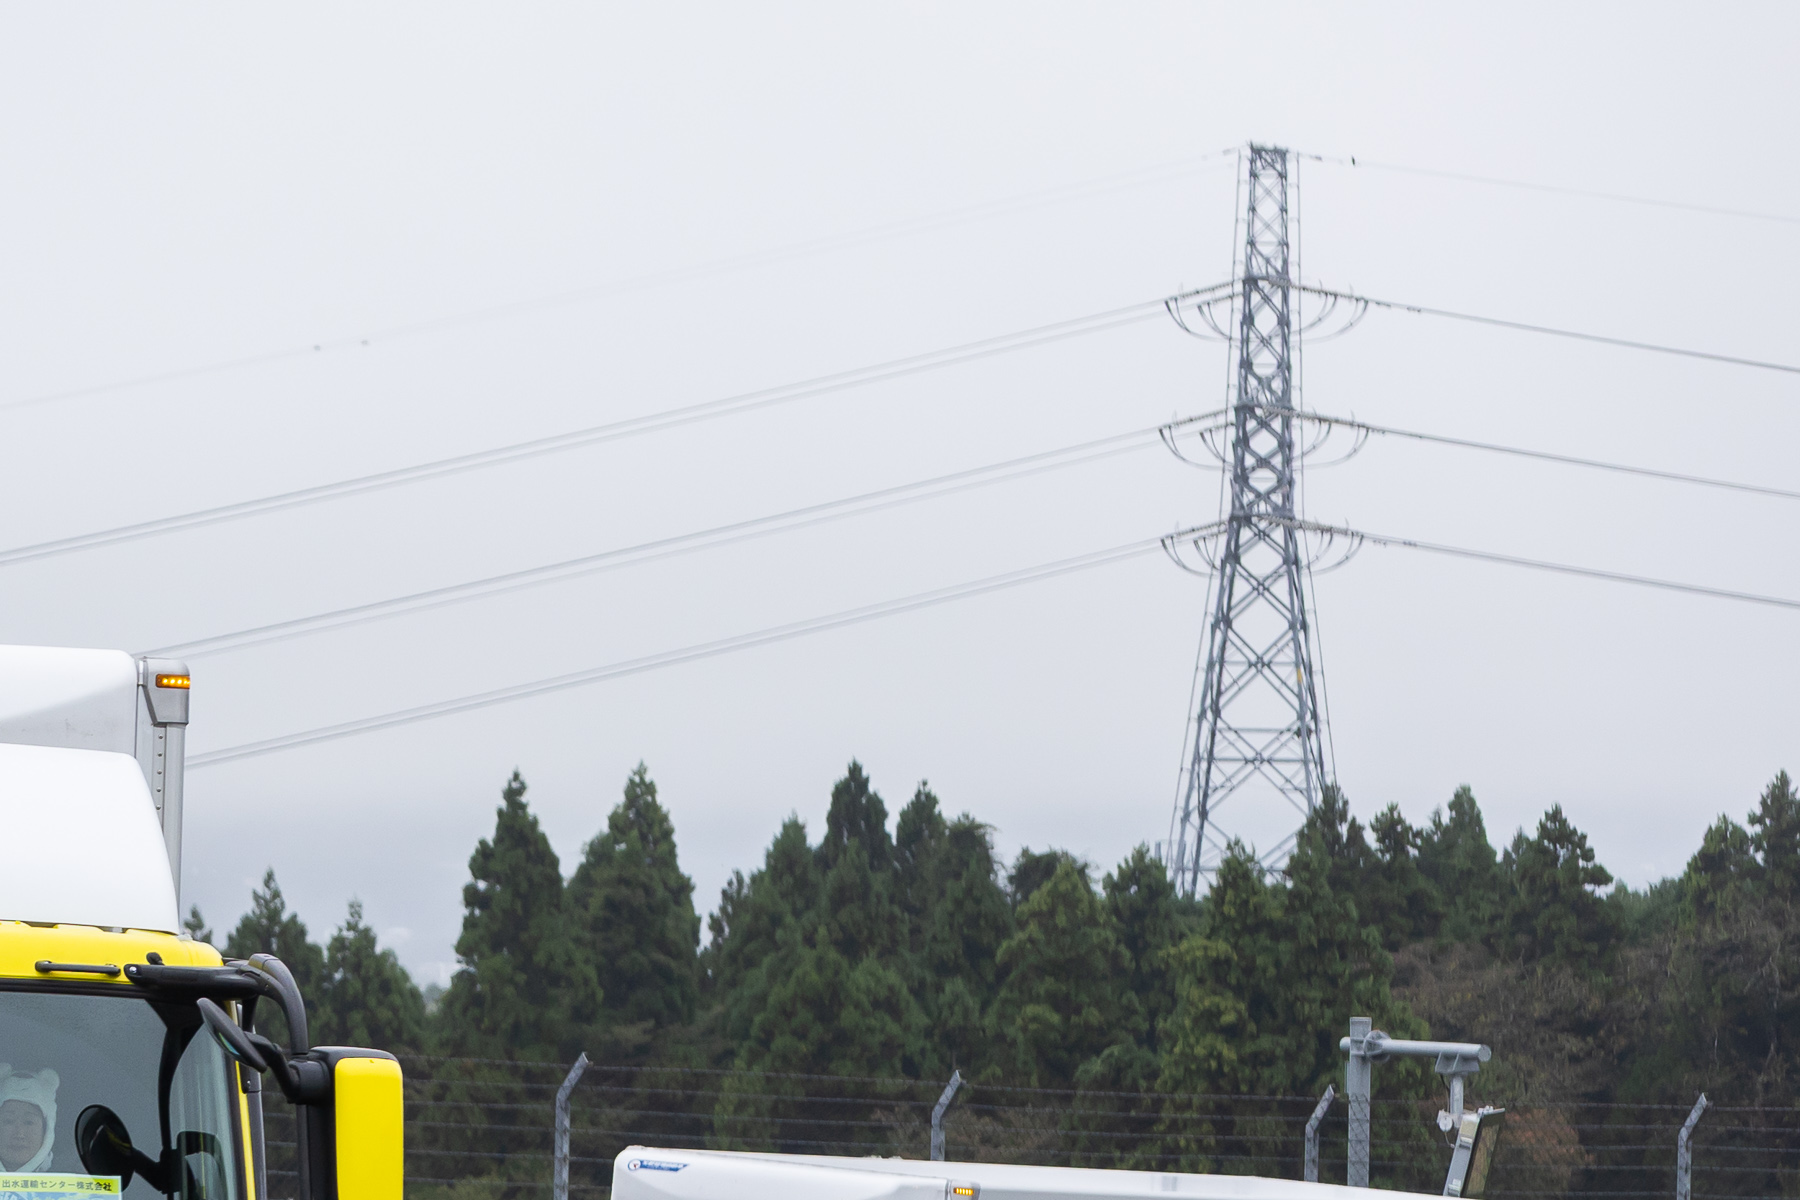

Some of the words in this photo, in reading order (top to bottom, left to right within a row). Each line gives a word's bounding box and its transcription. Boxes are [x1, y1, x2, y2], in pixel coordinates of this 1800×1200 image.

[2, 1179, 112, 1191] 出水運輸センター株式会社
